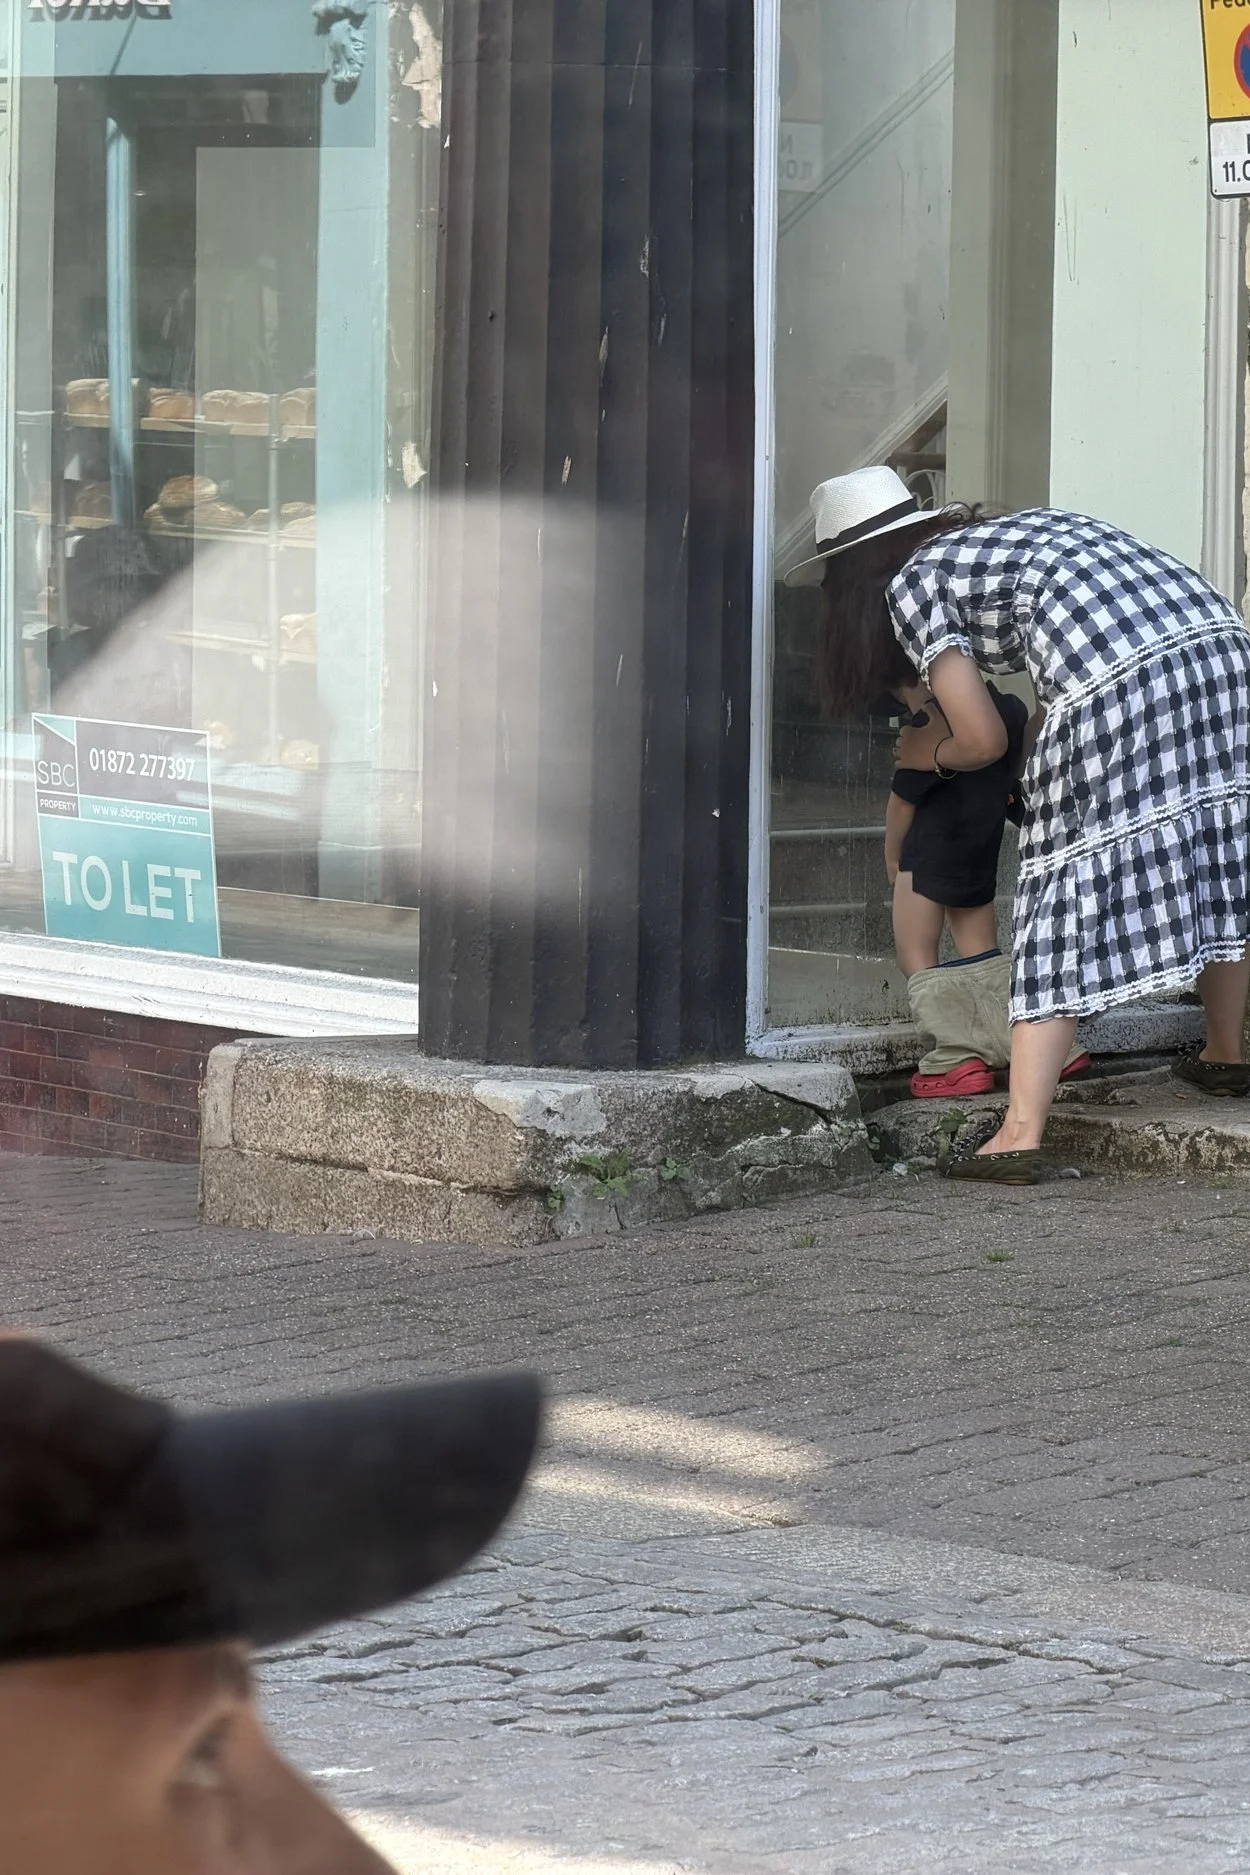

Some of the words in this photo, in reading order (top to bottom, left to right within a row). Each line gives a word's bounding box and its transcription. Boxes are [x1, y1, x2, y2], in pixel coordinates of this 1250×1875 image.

[37, 760, 75, 787] SBC
[89, 748, 136, 775] 01872
[139, 753, 195, 781] 277397
[40, 798, 76, 811] PROPERTY
[92, 803, 198, 826] www.sbcproperty.com
[52, 851, 112, 911] TO
[121, 860, 201, 923] LET
